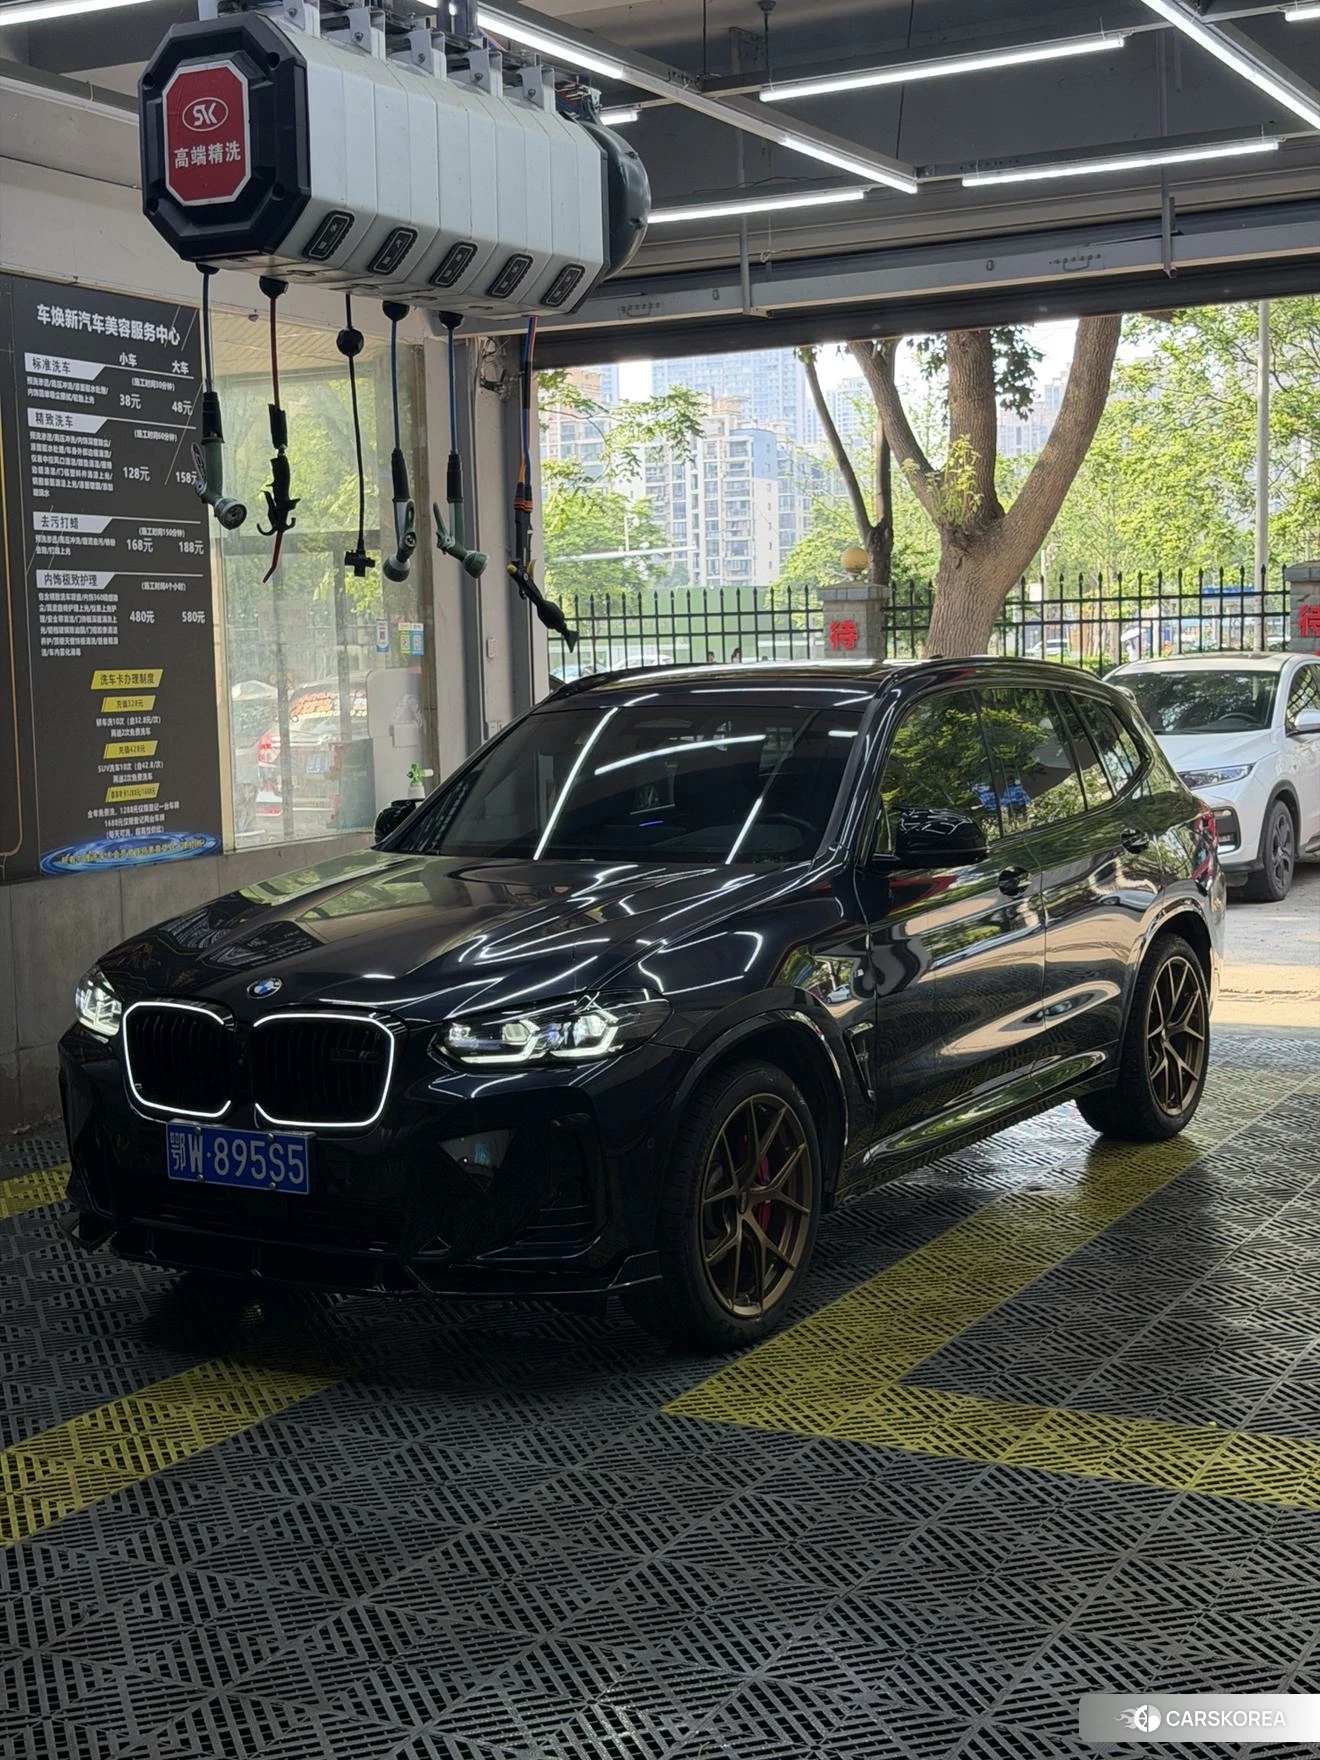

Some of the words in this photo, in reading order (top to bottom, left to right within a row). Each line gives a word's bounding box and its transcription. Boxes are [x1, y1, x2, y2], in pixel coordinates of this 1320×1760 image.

[174, 141, 241, 169] 高端精洗
[36, 304, 181, 346] 车焕新汽车美容服务中心
[32, 356, 71, 374] 标准洗车
[119, 352, 138, 367] 小车
[172, 360, 190, 375] 大车
[119, 393, 142, 410] 38元
[172, 400, 193, 416] 48元
[35, 411, 73, 428] 精致洗车
[123, 466, 151, 482] 128元
[40, 515, 79, 530] 去污打蜡
[126, 538, 154, 553] 168元
[179, 540, 204, 555] 188元
[44, 573, 97, 587] 内饰极致护理
[129, 610, 155, 624] 480元
[182, 611, 206, 624] 580元
[829, 618, 858, 651] 待
[100, 673, 155, 685] 洗车卡办理制度
[170, 1131, 304, 1185] 鄂W·895S5
